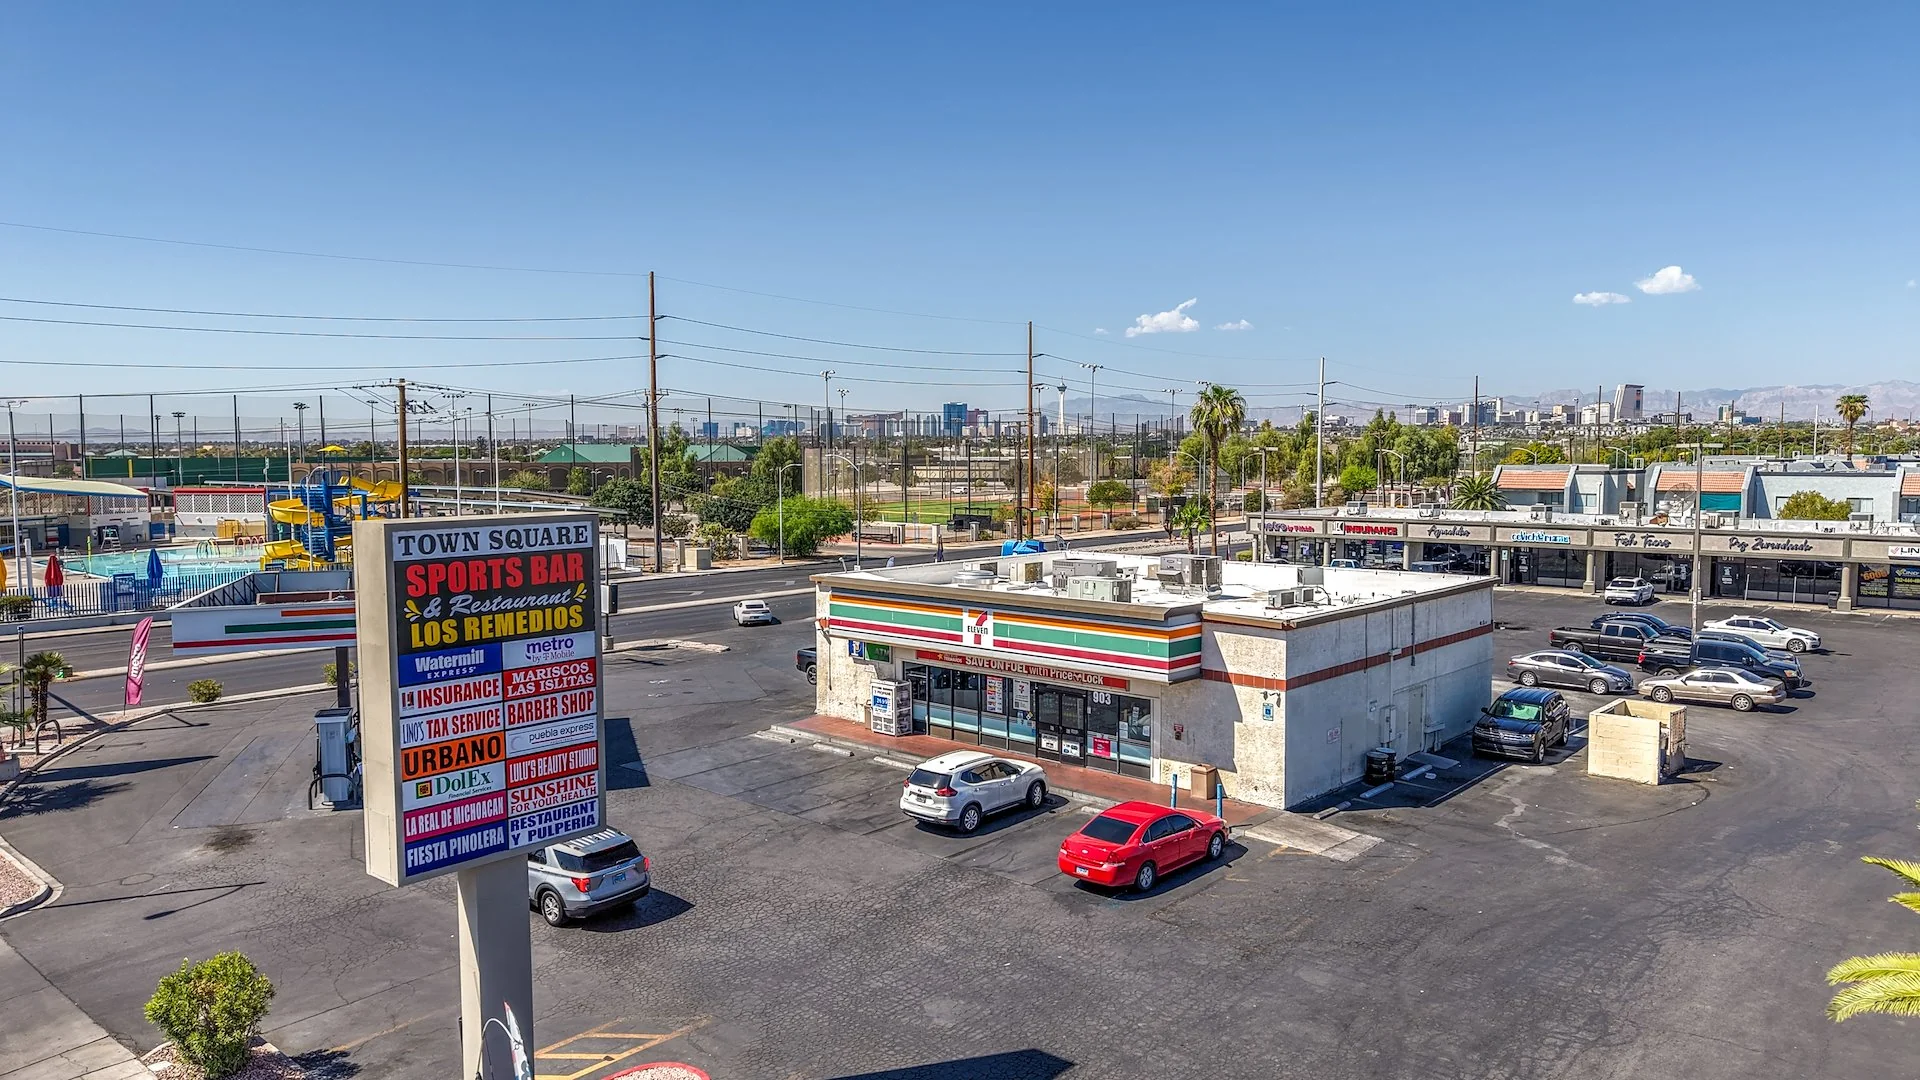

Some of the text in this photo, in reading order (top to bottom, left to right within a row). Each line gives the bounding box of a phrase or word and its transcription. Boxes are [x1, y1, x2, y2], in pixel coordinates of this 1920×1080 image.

[398, 525, 588, 556] TOWN SQUARE
[1344, 524, 1399, 536] INSURANCE
[1614, 531, 1672, 548] Fish Tacos
[406, 552, 585, 598] SPORTS BAR
[423, 588, 572, 618] & Restaurant
[411, 605, 584, 649] LOS REMEDIOS
[130, 643, 141, 678] metro
[415, 648, 485, 673] Watermill
[527, 637, 574, 654] metro
[532, 655, 541, 664] by
[427, 666, 477, 679] EXPRESS
[512, 662, 589, 684] MARISCOS
[965, 656, 990, 668] SAVE
[990, 660, 1004, 670] ON
[1005, 662, 1028, 674] FUEL
[1028, 665, 1049, 677] with
[1050, 668, 1073, 681] Price
[417, 678, 500, 709] INSURANCE
[507, 673, 594, 698] LAS ISLITAS
[1093, 691, 1112, 705] 903
[508, 690, 594, 726] BARBER SHOP
[402, 708, 501, 744] LINO'S TAX SERVICE
[529, 729, 558, 743] puebla
[560, 722, 594, 736] express
[404, 735, 502, 777] URBANO
[509, 747, 597, 784] LULU'S BEAUTY STUDIO
[434, 768, 491, 795] DolEx
[448, 785, 492, 800] Financial Services
[511, 773, 596, 805] SUNSHINE
[511, 786, 597, 815] FOR YOUR HEALTH
[405, 796, 504, 837] LA REAL DE MICHOACAN
[510, 800, 597, 832] RESTAURANT
[511, 813, 596, 846] Y PULPERIA
[407, 826, 505, 869] FIESTA PINOLERA
